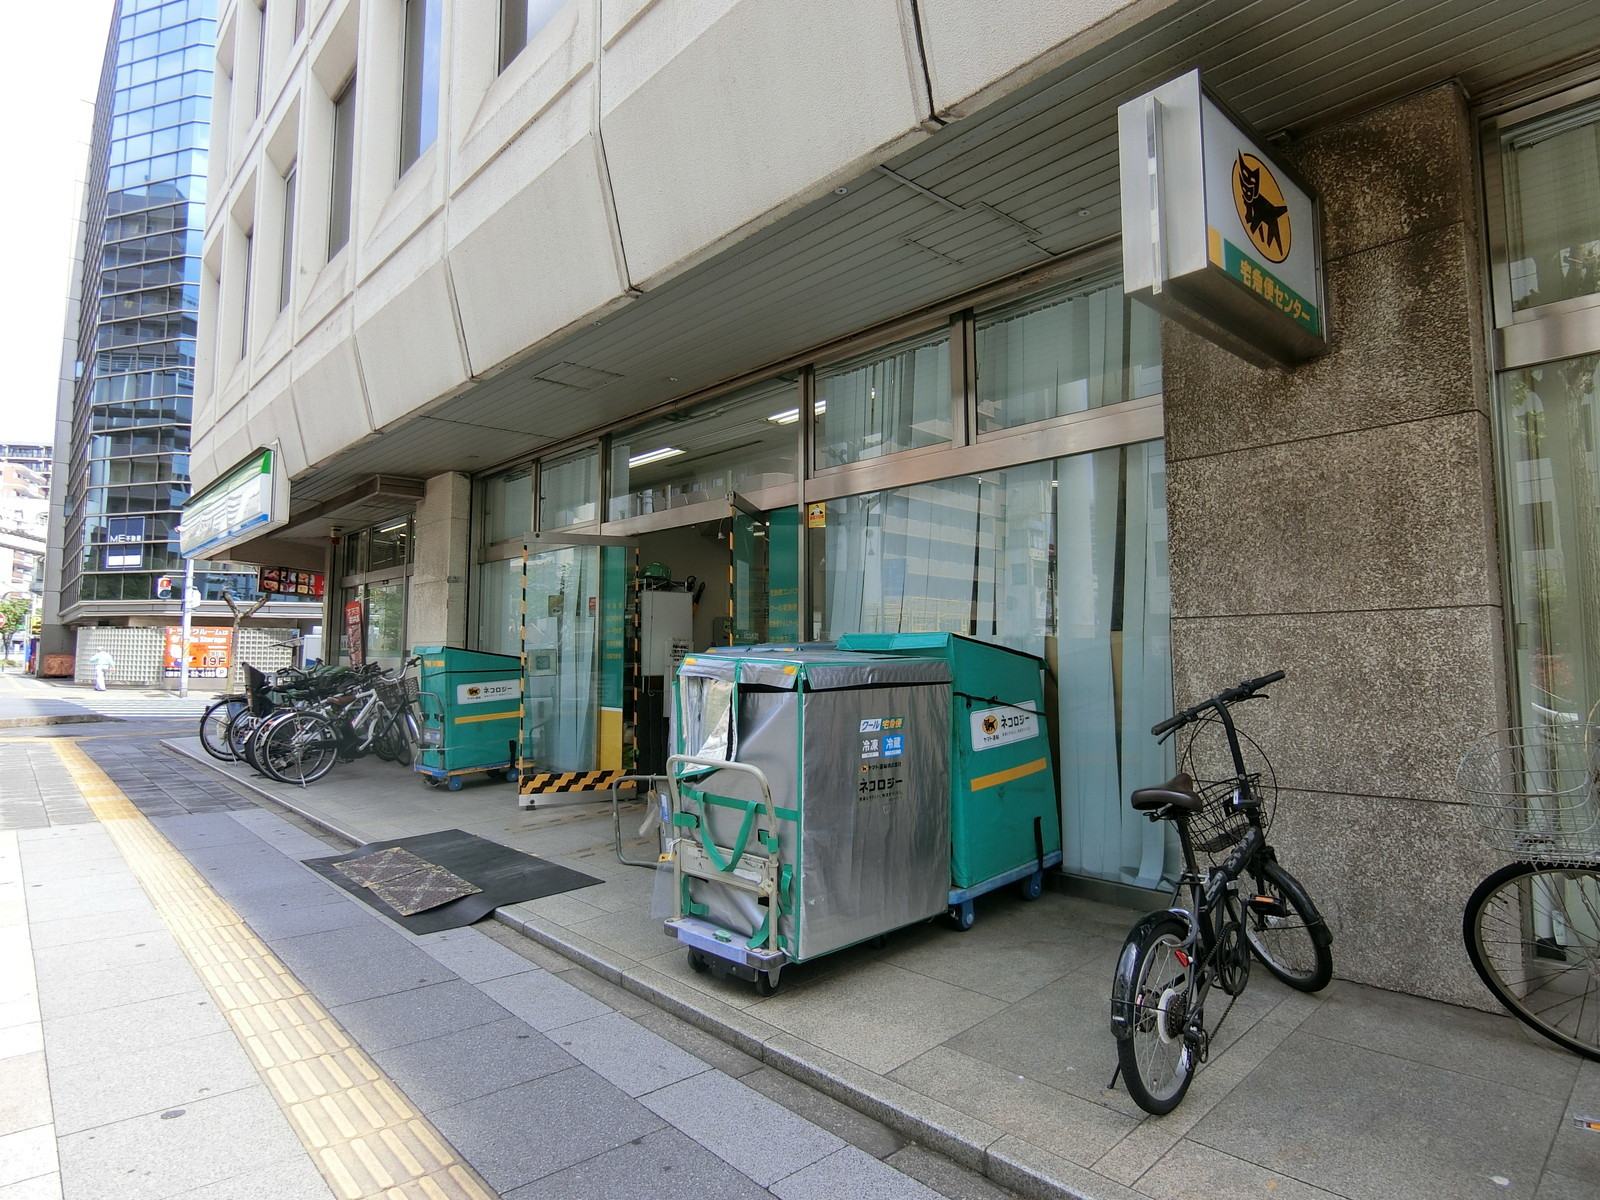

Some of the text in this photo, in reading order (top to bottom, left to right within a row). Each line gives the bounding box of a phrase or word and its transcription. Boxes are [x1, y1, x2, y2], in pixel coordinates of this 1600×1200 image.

[1241, 260, 1311, 321] 宅急便センター
[483, 686, 513, 694] ネコロジー
[861, 718, 902, 731] クール 宅急便
[1001, 714, 1030, 729] ネコロジー
[862, 736, 901, 752] 冷凍 冷蔵
[983, 734, 1000, 742] ヤマト運輸
[859, 778, 903, 793] ネコロジー
